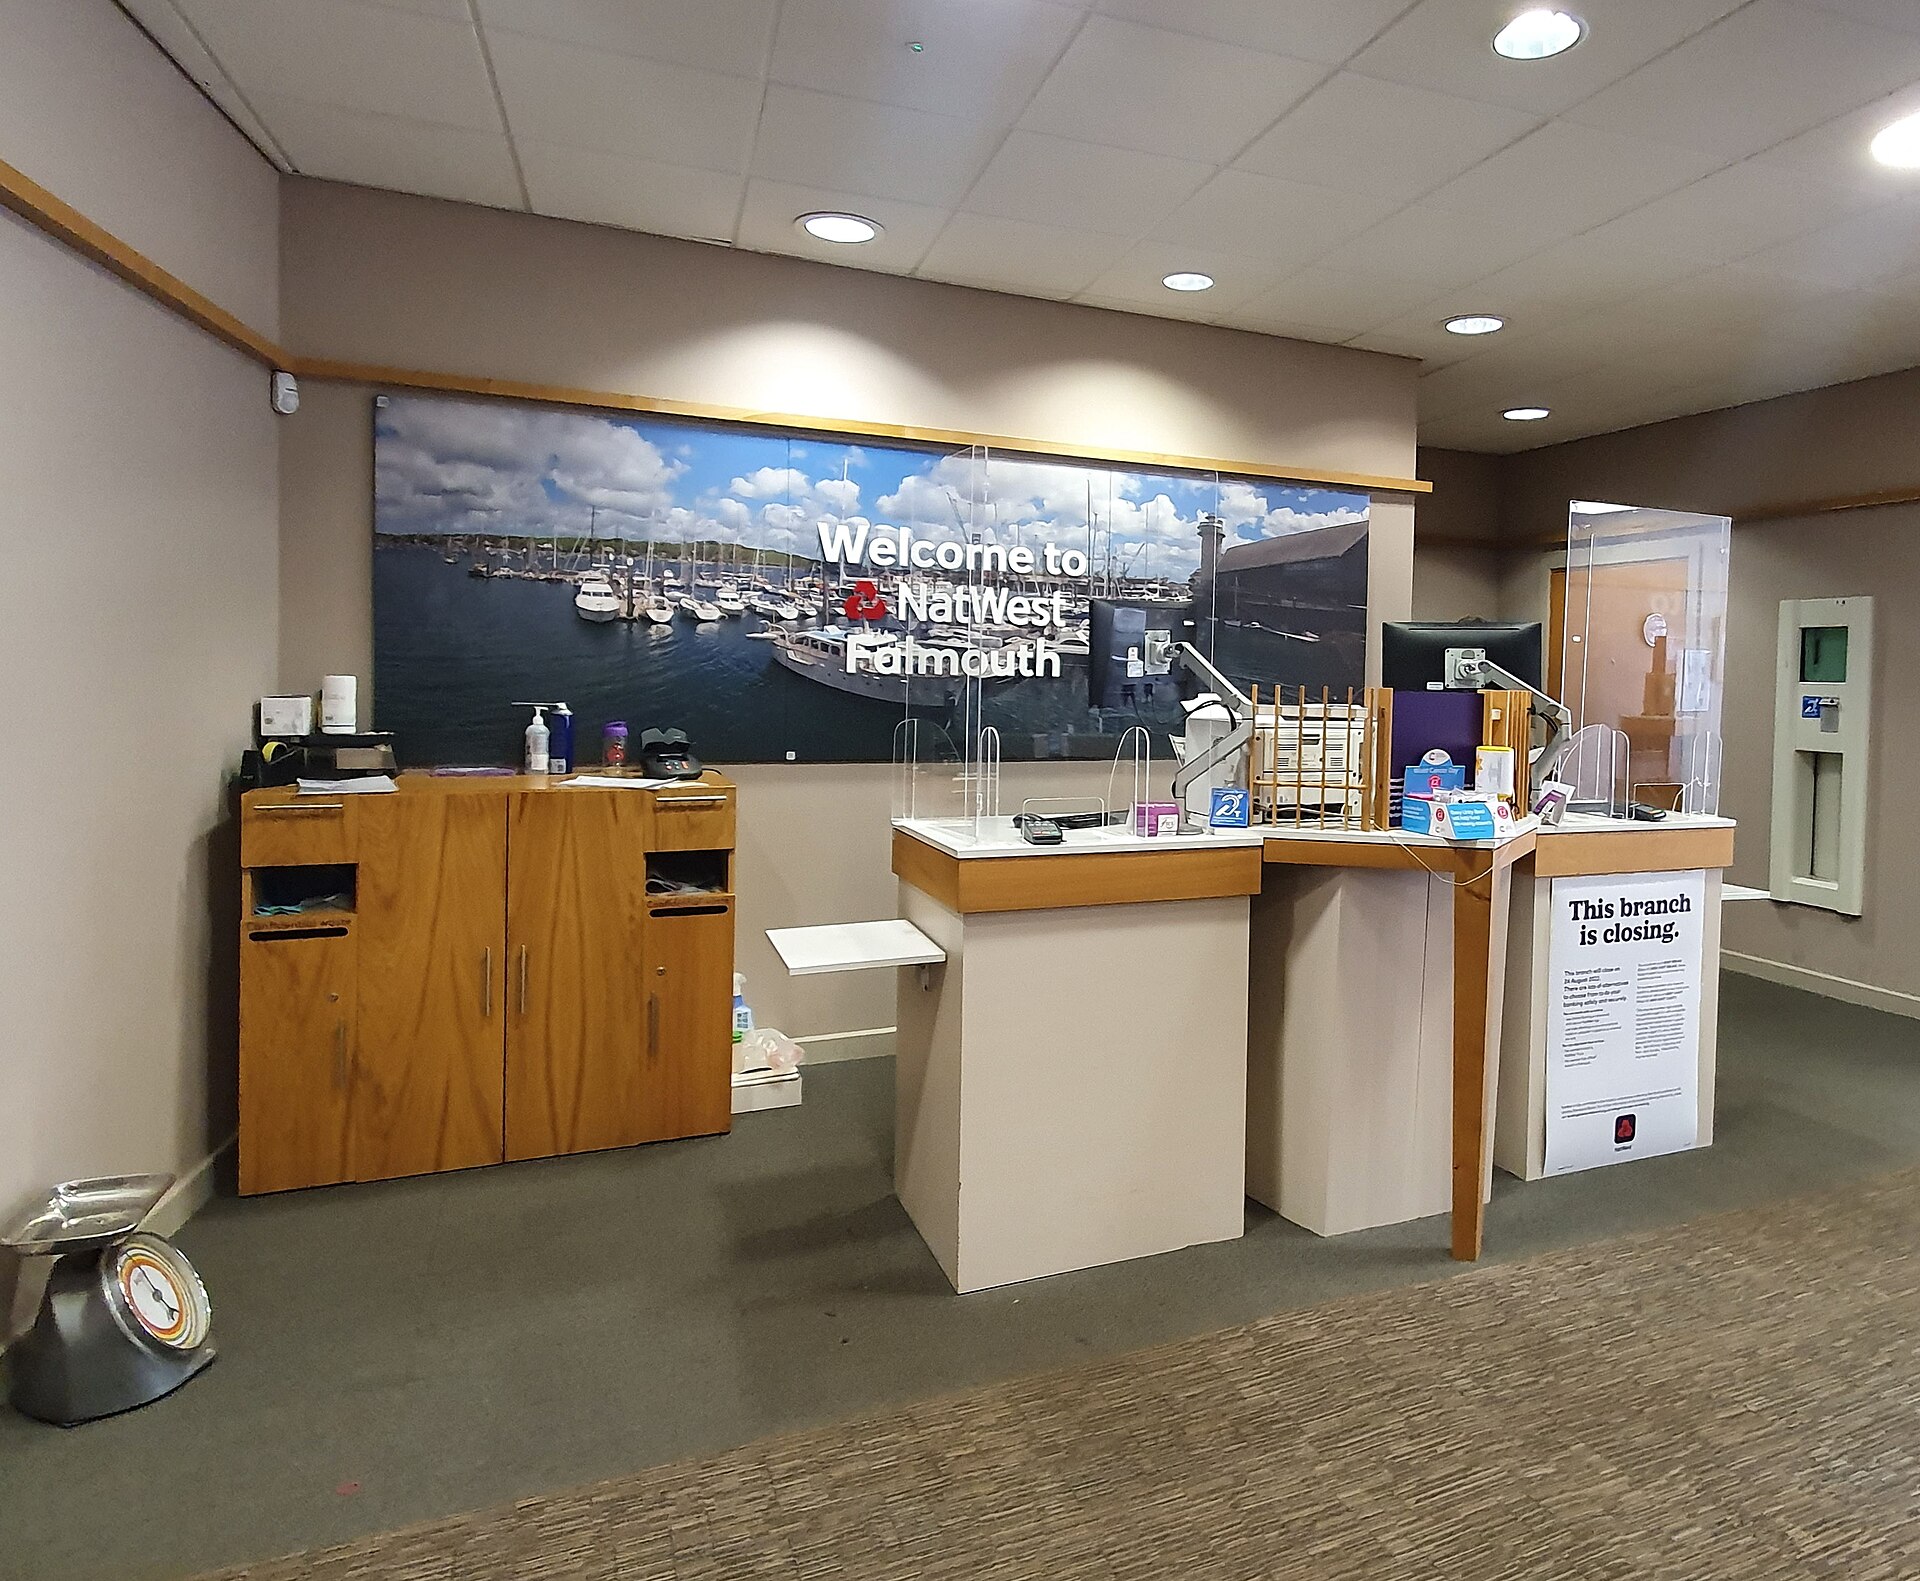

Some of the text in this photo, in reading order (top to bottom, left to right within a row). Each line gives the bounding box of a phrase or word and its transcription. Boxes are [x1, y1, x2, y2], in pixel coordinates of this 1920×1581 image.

[816, 518, 1086, 577] Welcome to
[898, 583, 1066, 626] NatWest
[846, 635, 1060, 678] Falmouth
[1569, 894, 1691, 920] This branch
[1580, 920, 1679, 945] is closing.
